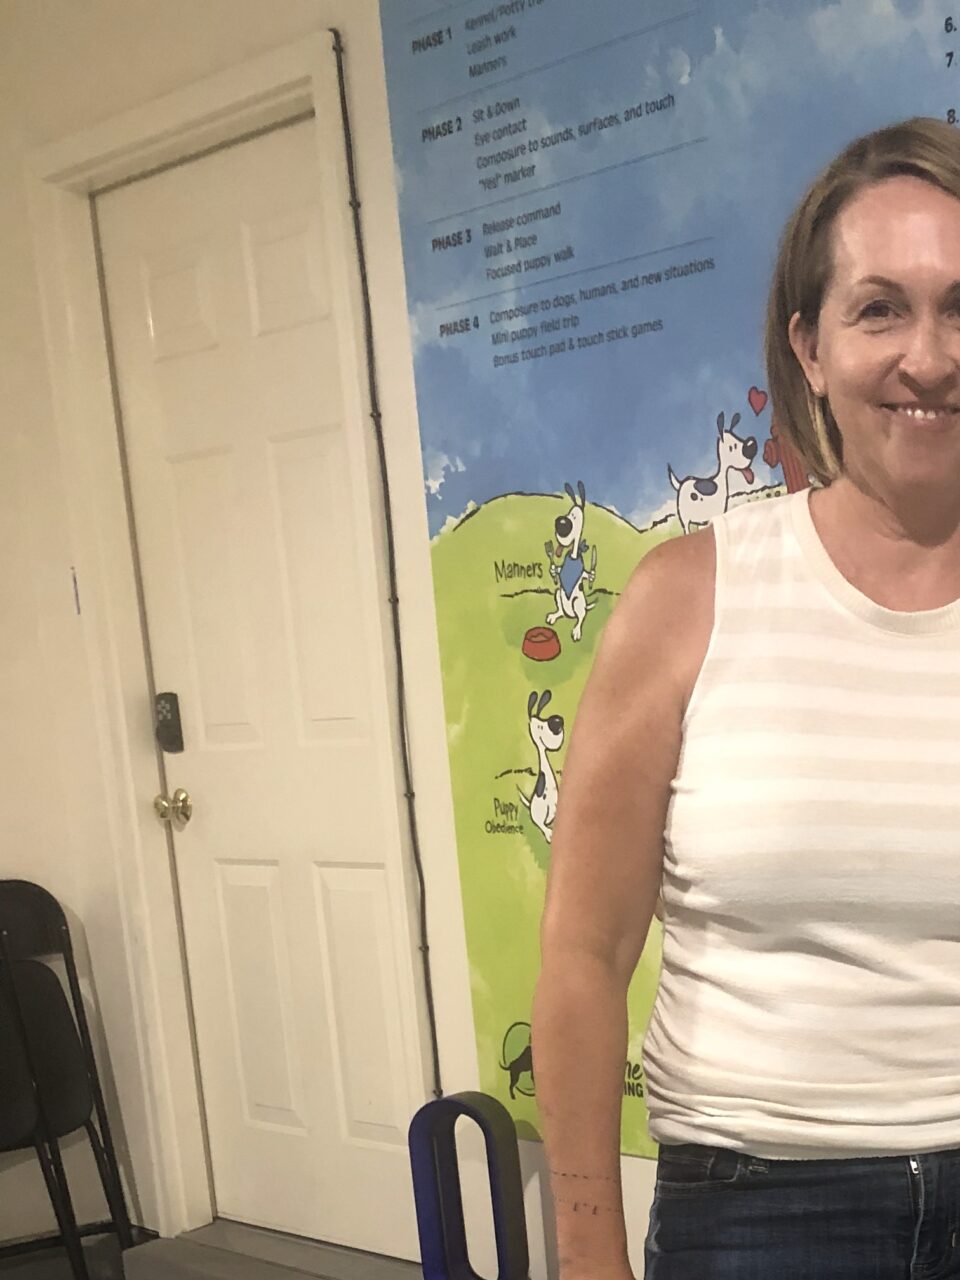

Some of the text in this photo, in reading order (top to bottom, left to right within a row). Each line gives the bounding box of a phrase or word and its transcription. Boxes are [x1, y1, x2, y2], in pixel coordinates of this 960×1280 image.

[494, 25, 516, 45] work
[944, 16, 957, 33] 6.
[412, 27, 452, 54] PHASE 1
[487, 105, 493, 119] &
[495, 97, 520, 116] Down
[946, 108, 959, 124] 8.
[422, 116, 462, 142] PHASE 2
[474, 118, 527, 147] Eye contact
[476, 144, 527, 170] Composure
[528, 139, 539, 153] to
[624, 104, 642, 122] and
[645, 93, 675, 115] touch
[504, 164, 536, 184] marker
[483, 201, 561, 236] Release command
[432, 228, 472, 252] PHASE 3
[484, 234, 537, 258] Wait & Place
[486, 245, 575, 281] Focused puppy walk
[490, 302, 539, 324] Composure
[540, 299, 551, 311] to
[621, 274, 639, 291] and
[641, 273, 662, 286] new
[664, 257, 715, 281] situations
[440, 315, 479, 338] PHASE 4
[491, 314, 580, 345] Mini puppy field trip
[493, 319, 663, 368] Bonus touch pad & touch stick games
[494, 559, 543, 583] Manners
[493, 797, 519, 821] Puppy
[485, 820, 524, 834] Obedience
